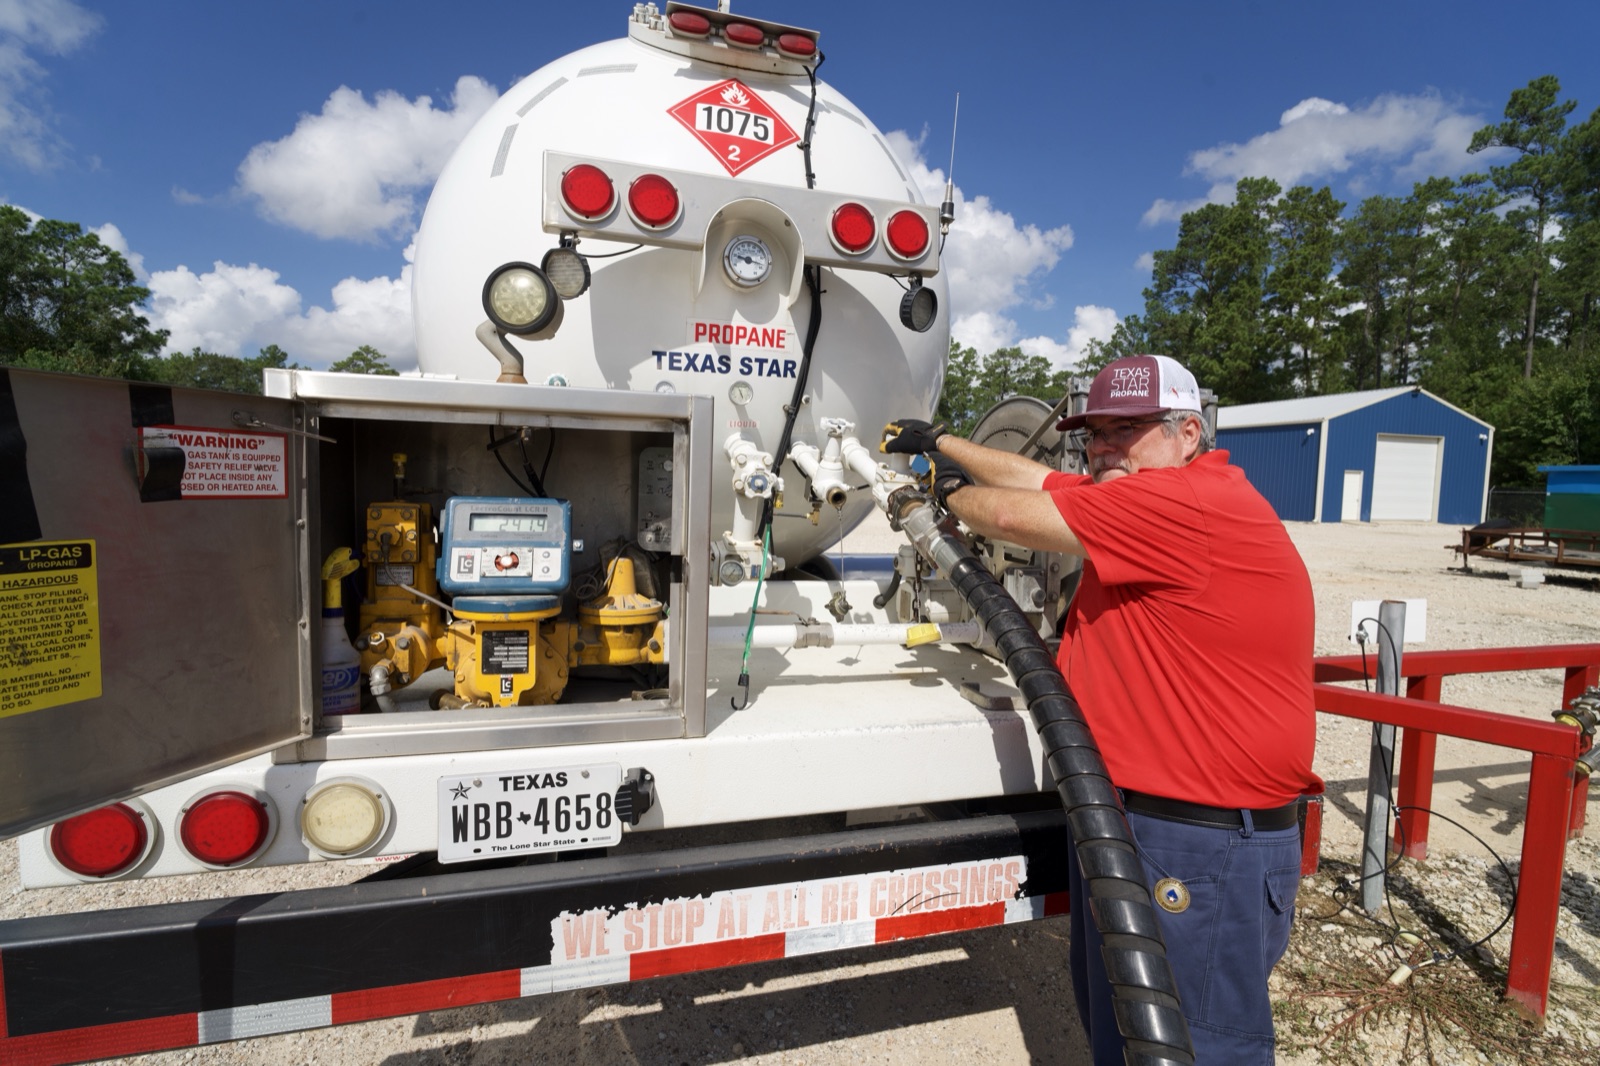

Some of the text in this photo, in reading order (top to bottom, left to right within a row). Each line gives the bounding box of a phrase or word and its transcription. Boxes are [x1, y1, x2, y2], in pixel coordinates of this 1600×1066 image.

[702, 104, 770, 142] 1075
[727, 144, 741, 162] 2
[694, 322, 786, 349] PROPANE
[652, 350, 797, 379] TEXAS STAR
[1114, 367, 1150, 378] TEXAS
[1111, 377, 1150, 391] STAR
[1110, 390, 1149, 398] PROPANE
[729, 420, 757, 429] LIQUID
[188, 451, 206, 460] GAS
[208, 452, 230, 460] TANK
[242, 453, 281, 462] EQUIPPED
[188, 462, 222, 470] SAFETY
[224, 463, 252, 471] RELIEF
[229, 473, 255, 481] INSIDE
[207, 483, 219, 491] OR
[222, 483, 253, 491] HEATED
[20, 546, 82, 561] LP-GAS
[27, 559, 78, 570] (PROPANE)
[2, 574, 79, 588] HAZARDOUS
[24, 592, 47, 600] STOP
[50, 588, 82, 597] FILLING
[1, 595, 89, 611] CHECK AFTER EACH
[21, 607, 57, 617] OUTAGE
[58, 603, 84, 612] VALVE
[64, 611, 87, 619] AREA
[18, 625, 38, 633] THIS
[40, 622, 62, 630] TANK
[65, 619, 75, 627] TO
[9, 630, 62, 642] MAINTAINED
[30, 639, 60, 648] LOCAL
[43, 643, 76, 654] AND/OR
[11, 654, 58, 668] PAMPHLET
[10, 671, 57, 684] MATERIAL.
[59, 667, 72, 675] NO
[20, 682, 40, 690] THIS
[42, 671, 91, 686] EQUIPMENT
[13, 685, 60, 700] QUALIFIED
[62, 681, 80, 690] AND
[1, 699, 33, 711] DO SO.
[499, 772, 568, 792] TEXAS
[510, 843, 531, 851] Lone
[533, 841, 551, 849] Star
[553, 838, 576, 847] State
[561, 861, 1020, 961] WE STOP AT ALL RR CROSSINGS
